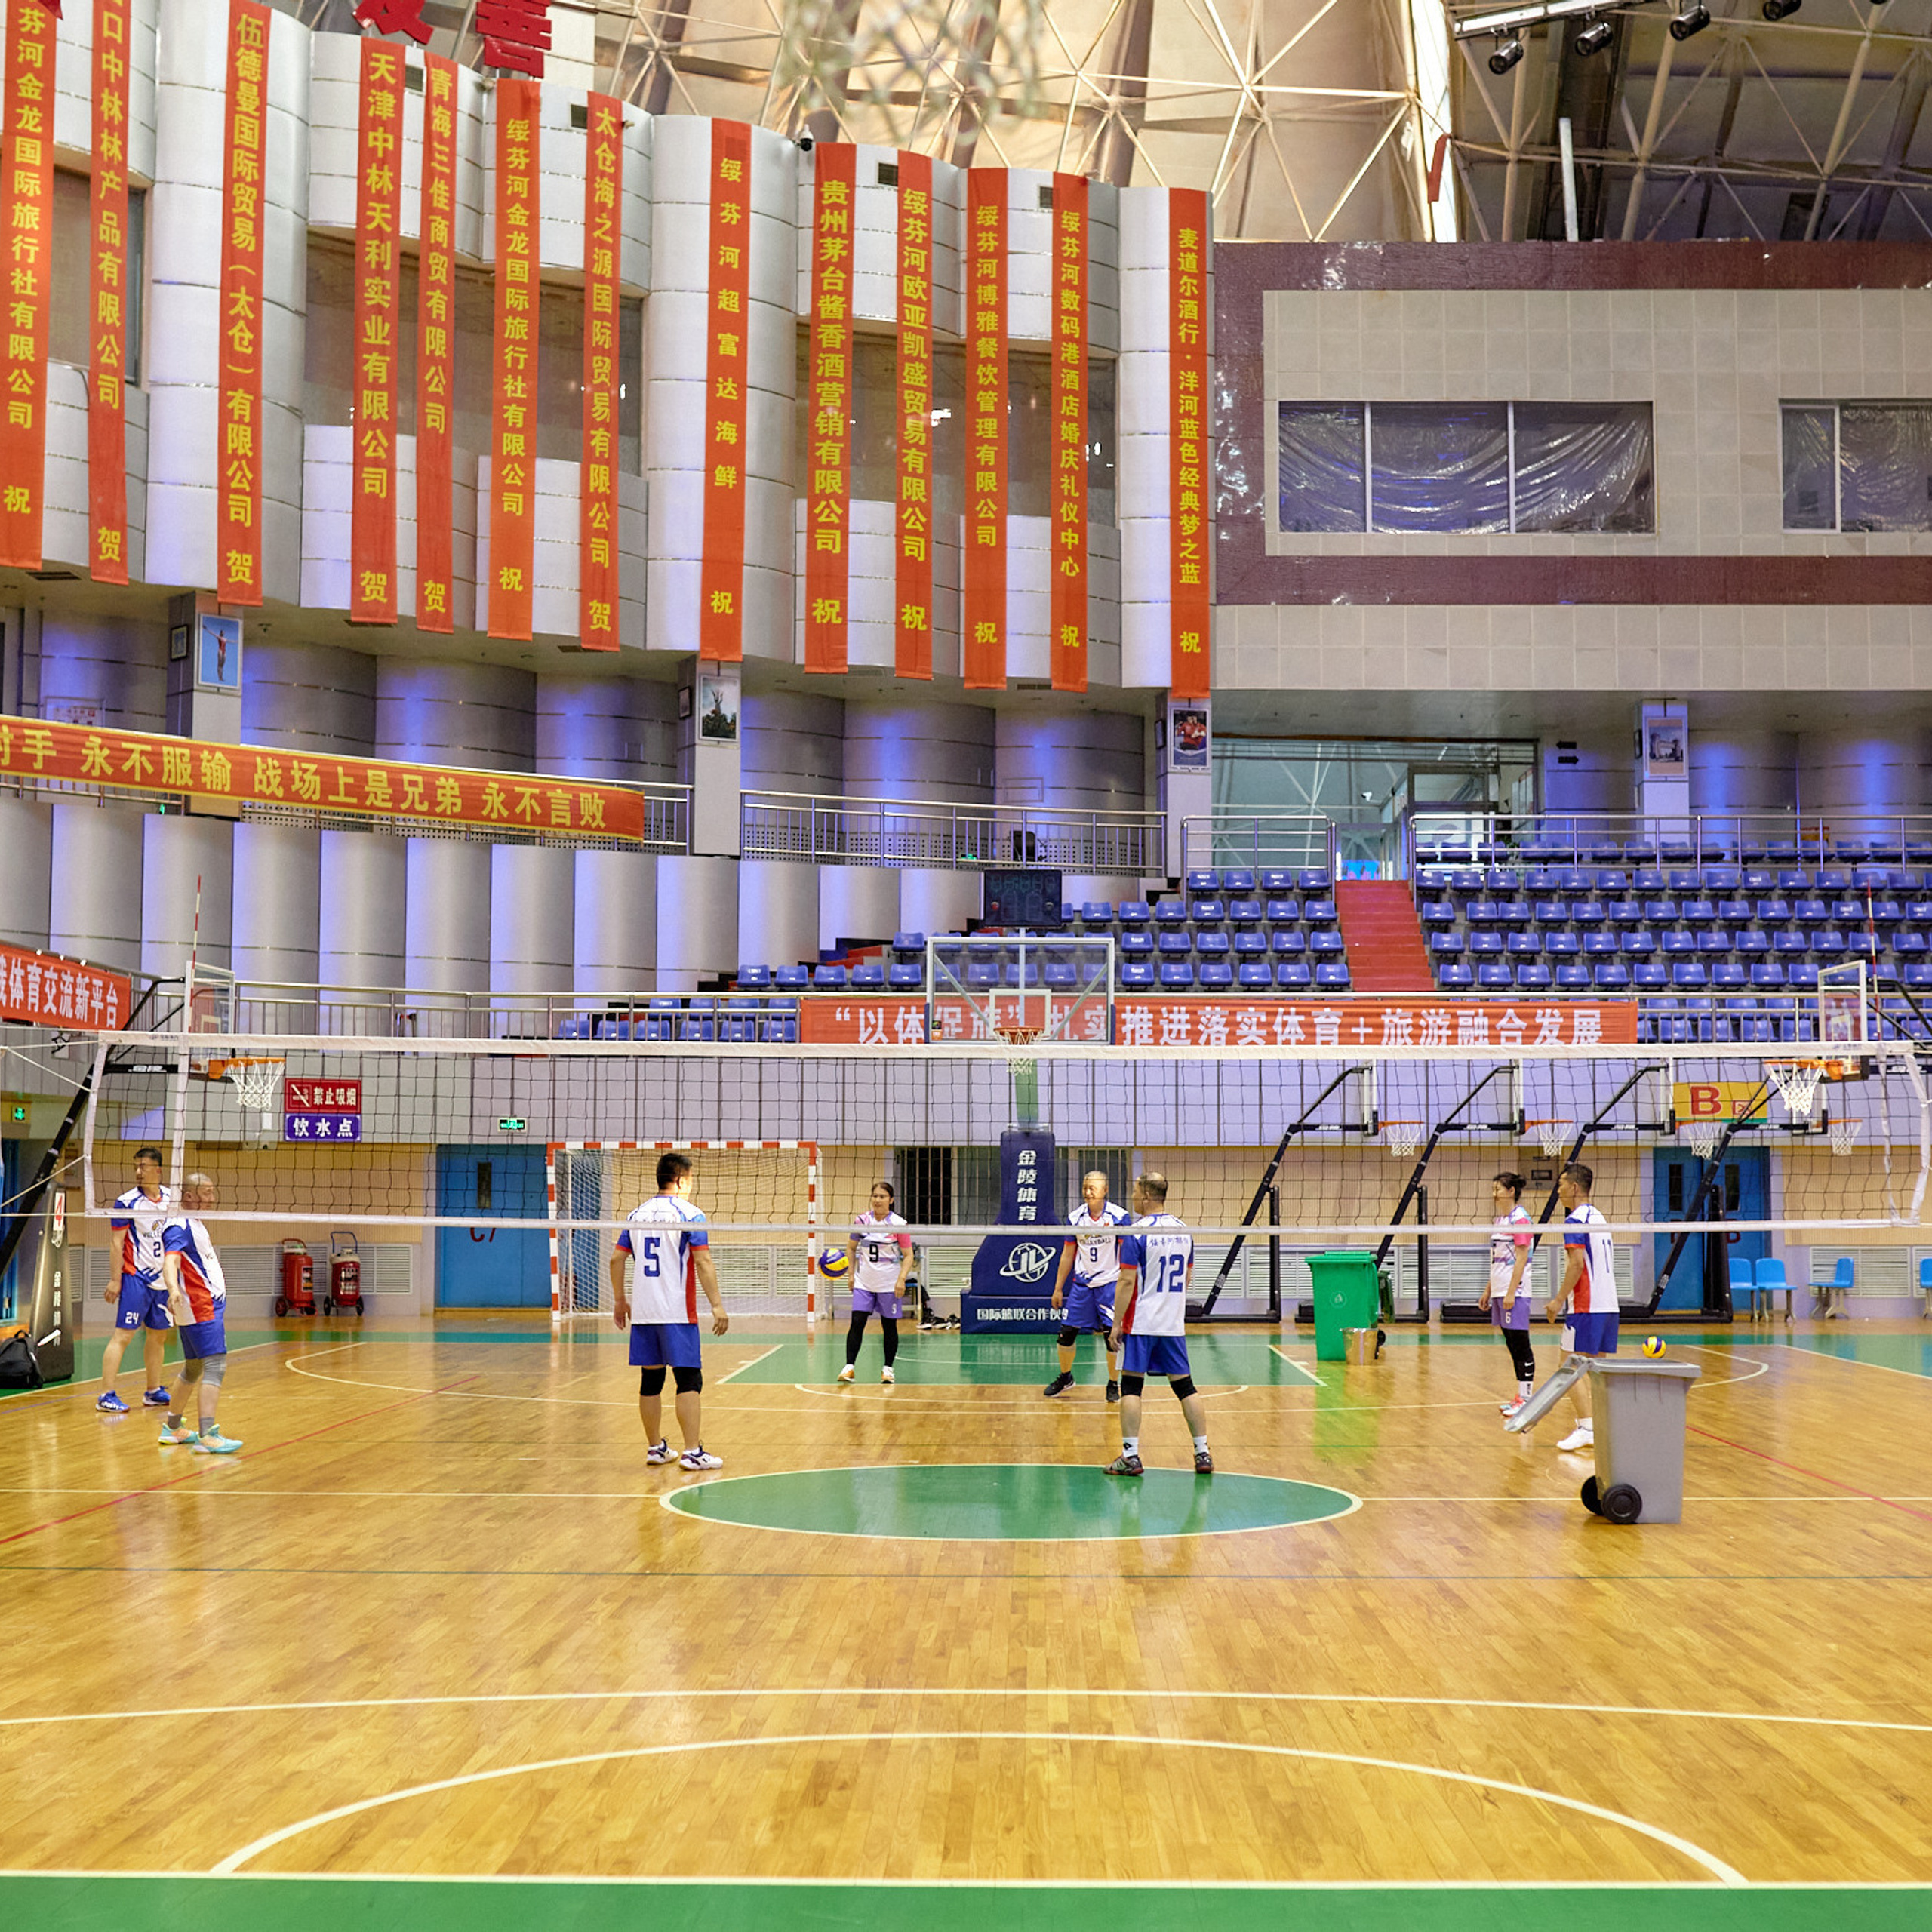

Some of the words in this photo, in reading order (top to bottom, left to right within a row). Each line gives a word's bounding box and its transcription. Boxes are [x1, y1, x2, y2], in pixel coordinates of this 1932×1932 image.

[8, 0, 46, 430] 芬河金龙国际旅行社有限公司
[97, 0, 124, 410] 口中林林产品有限公司
[4, 486, 32, 515] 祝
[99, 528, 122, 562] 贺
[228, 551, 254, 585] 贺
[500, 568, 524, 592] 祝
[361, 571, 388, 604] 贺
[425, 581, 446, 614] 贺
[590, 600, 611, 632] 贺
[711, 591, 734, 615] 祝
[813, 599, 843, 625] 祝
[902, 605, 928, 632] 祝
[975, 623, 998, 644] 祝
[1061, 625, 1081, 648] 祝
[1180, 632, 1201, 654] 祝
[80, 734, 232, 792] 永不服输
[253, 756, 463, 815] 战场上是兄弟
[481, 781, 607, 829] 永不言败
[313, 1086, 356, 1106] 禁止吸烟
[1690, 1086, 1721, 1115] B
[293, 1118, 353, 1137] 饮水点
[1017, 1149, 1038, 1221] 金陵体育
[644, 1237, 660, 1277] 5
[869, 1244, 878, 1263] 9
[1090, 1247, 1098, 1263] 9
[1156, 1254, 1185, 1293] 12
[125, 1312, 140, 1325] 24
[1505, 1312, 1512, 1324] 6
